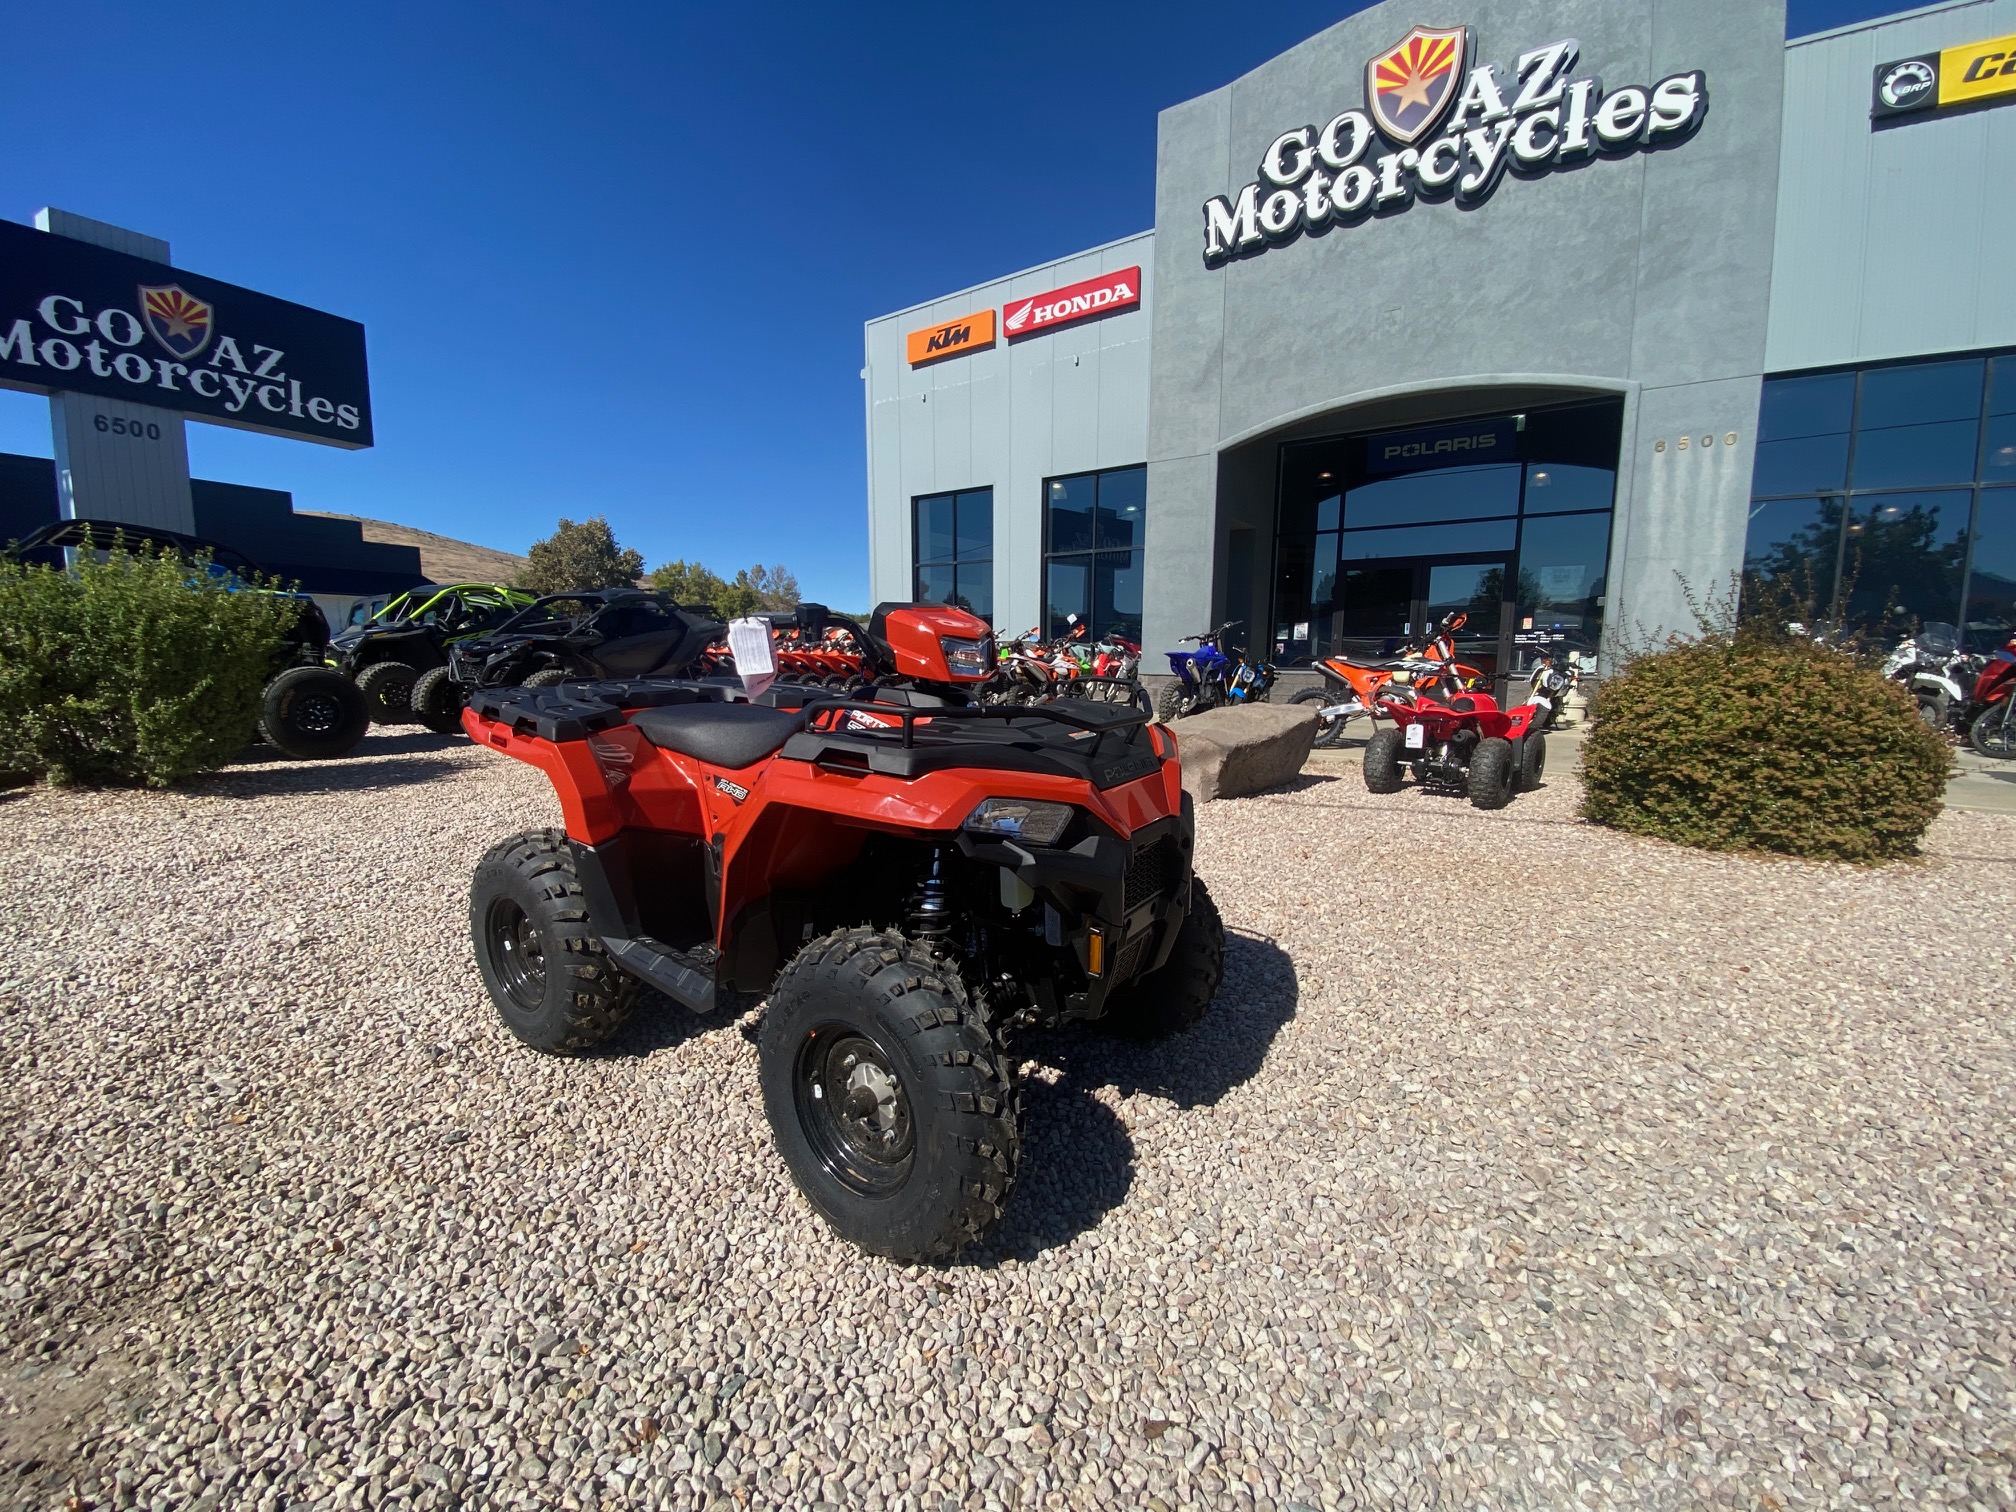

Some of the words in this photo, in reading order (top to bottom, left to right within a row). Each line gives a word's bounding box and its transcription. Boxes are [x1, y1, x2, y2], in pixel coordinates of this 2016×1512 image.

[1901, 81, 1931, 94] BRP
[1262, 110, 1376, 185] GO
[1448, 39, 1575, 132] AZ
[1205, 71, 1700, 257] Motorcycles
[1033, 282, 1134, 323] HONDA
[37, 294, 144, 348] GO
[207, 335, 288, 381] AZ
[926, 323, 971, 353] KTM
[0, 319, 361, 430] Motorcycles
[94, 413, 161, 441] 6500
[1654, 431, 1738, 453] 6500
[1384, 433, 1497, 459] POLARIS
[716, 781, 748, 800] AWD
